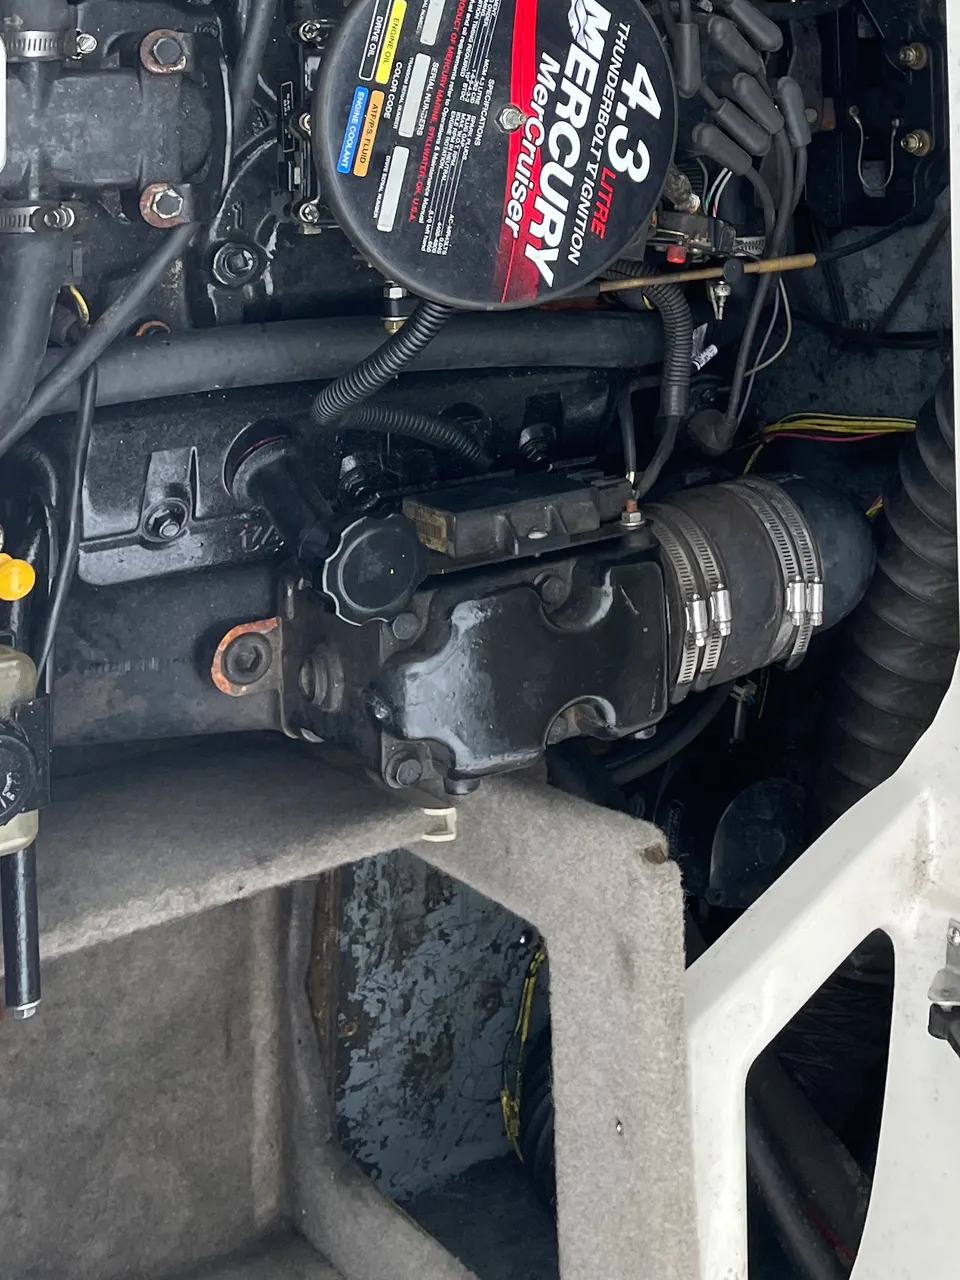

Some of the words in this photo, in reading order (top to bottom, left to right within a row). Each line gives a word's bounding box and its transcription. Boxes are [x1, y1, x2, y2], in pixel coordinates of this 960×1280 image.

[370, 15, 383, 42] DRIVE
[386, 17, 399, 49] ENGINE
[367, 43, 376, 57] OIL
[382, 50, 391, 64] OIL
[389, 61, 402, 92] COLOR
[426, 61, 439, 91] SERIAL
[590, 22, 630, 158] THUNDERBOLT
[350, 90, 364, 124] ENGINE
[383, 93, 395, 119] CODE
[473, 78, 495, 146] SPECIFICATIONS
[601, 62, 661, 182] 4.3
[339, 124, 356, 168] COOLANT
[359, 138, 370, 163] FLUID
[502, 51, 560, 239] MerCruiser
[590, 166, 619, 239] LITRE
[567, 176, 595, 265] IGNITION
